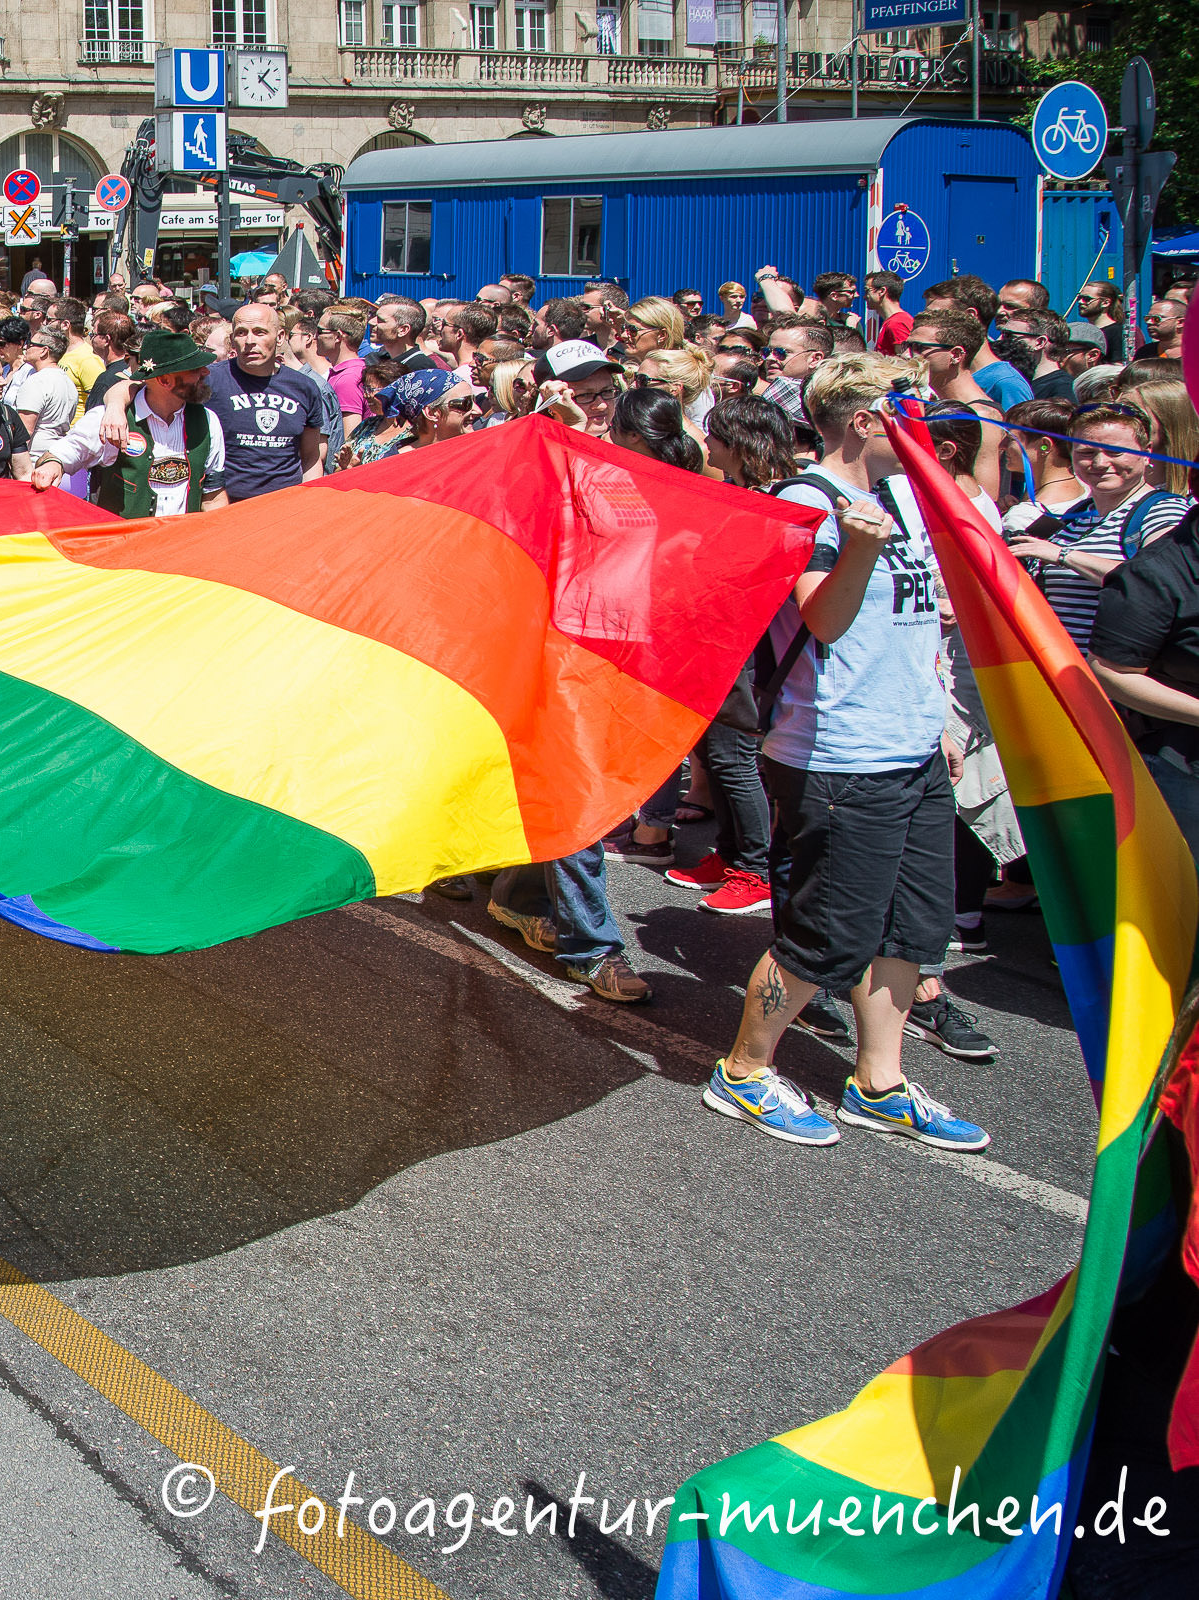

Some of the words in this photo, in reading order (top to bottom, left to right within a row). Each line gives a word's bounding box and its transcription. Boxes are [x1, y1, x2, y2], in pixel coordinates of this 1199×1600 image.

[689, 9, 713, 19] HAAR
[870, 0, 958, 19] PFAFFINGER
[180, 52, 219, 102] U
[94, 216, 111, 226] Tor
[161, 215, 185, 225] Cafe
[188, 216, 204, 224] am
[208, 213, 262, 226] Senger
[266, 213, 281, 223] Tor
[229, 392, 299, 415] NYPD
[240, 439, 268, 447] POLICE
[892, 571, 936, 614] PEC
